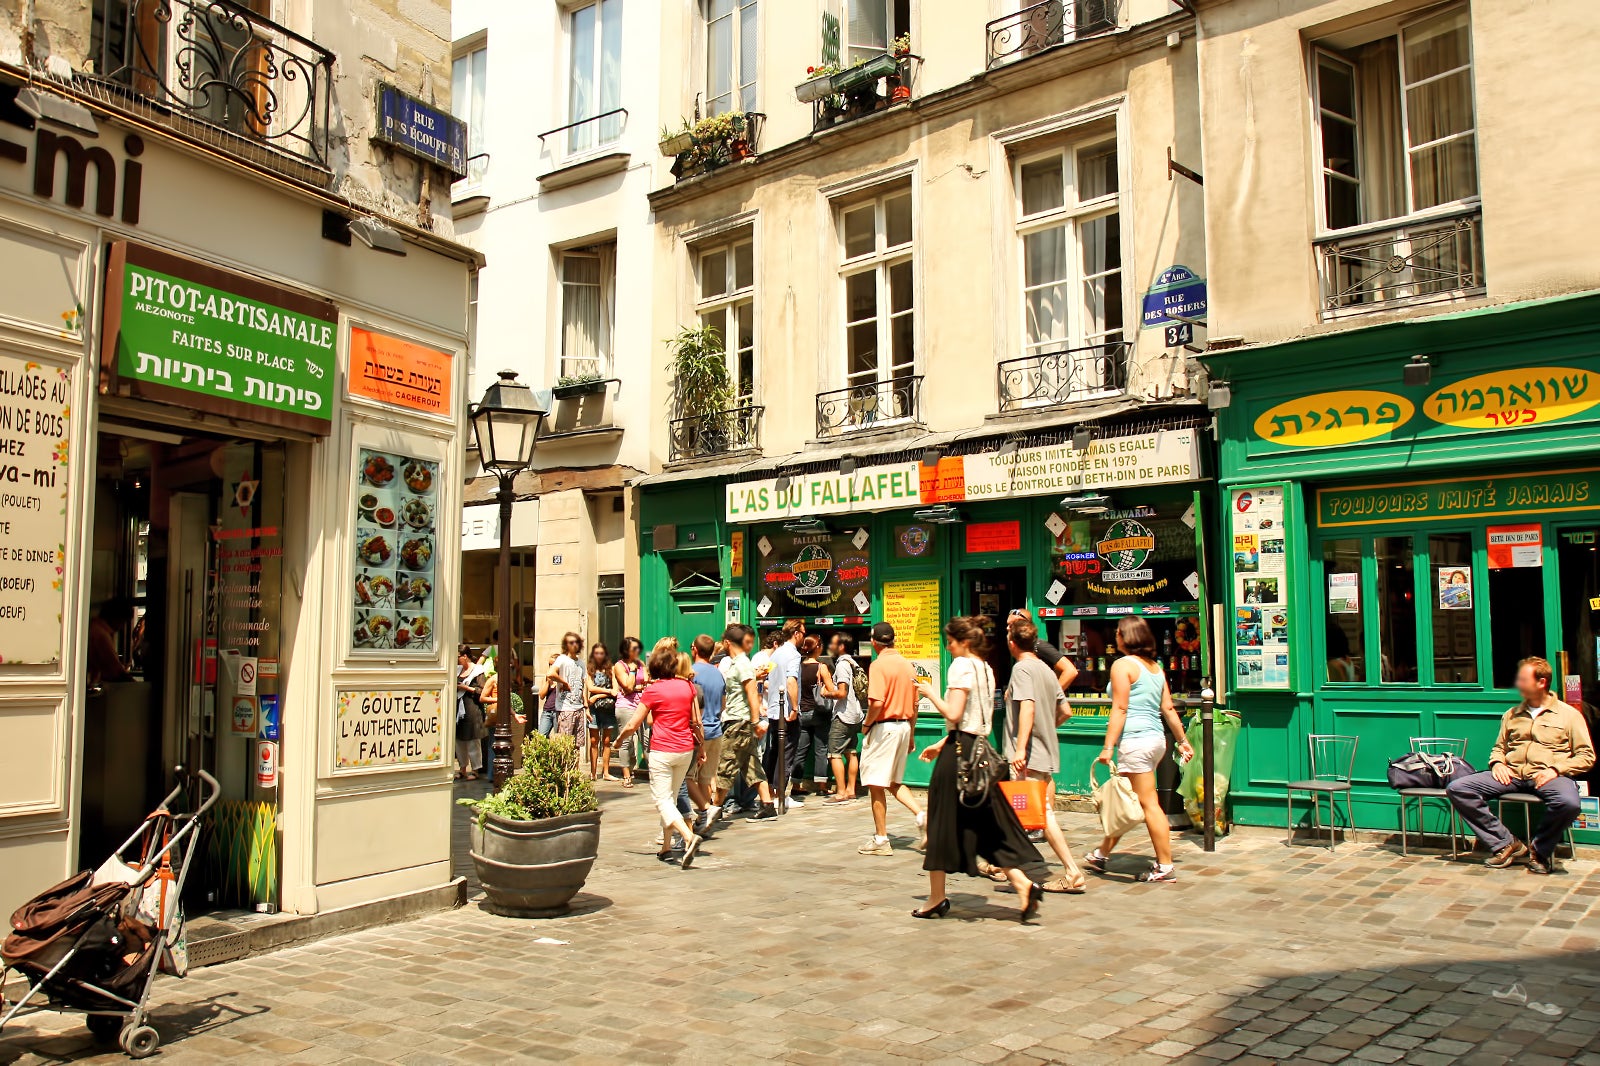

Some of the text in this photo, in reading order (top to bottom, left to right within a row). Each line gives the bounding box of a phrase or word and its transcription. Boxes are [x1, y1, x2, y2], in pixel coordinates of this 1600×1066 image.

[414, 110, 434, 131] RUE
[1164, 293, 1185, 305] RUE
[130, 272, 332, 349] PITOT-ARTISANALE
[135, 302, 195, 325] MEZONOTE
[1144, 300, 1206, 321] DES ROSIERS
[1168, 325, 1189, 344] 34
[172, 330, 295, 372] FAITES SUR PLACE
[305, 358, 324, 379] כשר
[364, 361, 403, 382] כשרות
[136, 351, 322, 410] פיתות ביתיות
[409, 371, 441, 393] תעודת
[51, 382, 66, 404] AU
[395, 391, 440, 407] CACHEROUT
[1434, 373, 1589, 417] שווארמה
[16, 408, 31, 433] DE
[35, 411, 63, 438] BOIS
[1270, 401, 1401, 437] פרגית
[1485, 408, 1537, 426] כשר
[989, 438, 1156, 467] TOUJOURS IMITE JAMAIS EGALE
[1007, 455, 1138, 478] MAISON FONDEE EN 1979
[967, 464, 1190, 496] SOUS LE CONTROLE DU BETH-DIN DE PARIS
[1, 493, 41, 511] (POULET)
[729, 470, 917, 514] L'AS DU FALLAFEL
[1329, 481, 1590, 516] TOUJOURS IMITÉ JAMAIS
[1098, 508, 1155, 520] SCHAWARMA
[793, 534, 832, 545] FALLAFEL
[900, 529, 930, 544] OPEN
[1235, 535, 1253, 546] 파리
[12, 549, 22, 561] DE
[26, 550, 54, 563] DINDE
[1059, 559, 1101, 574] כשר
[0, 577, 35, 592] (BOEUF)
[1087, 581, 1111, 595] Maison
[222, 617, 270, 632] Citronnade
[228, 636, 260, 646] maison
[361, 696, 421, 715] GOUTEZ
[341, 717, 438, 738] L'AUTHENTIQUE
[359, 738, 422, 760] FALAFEL
